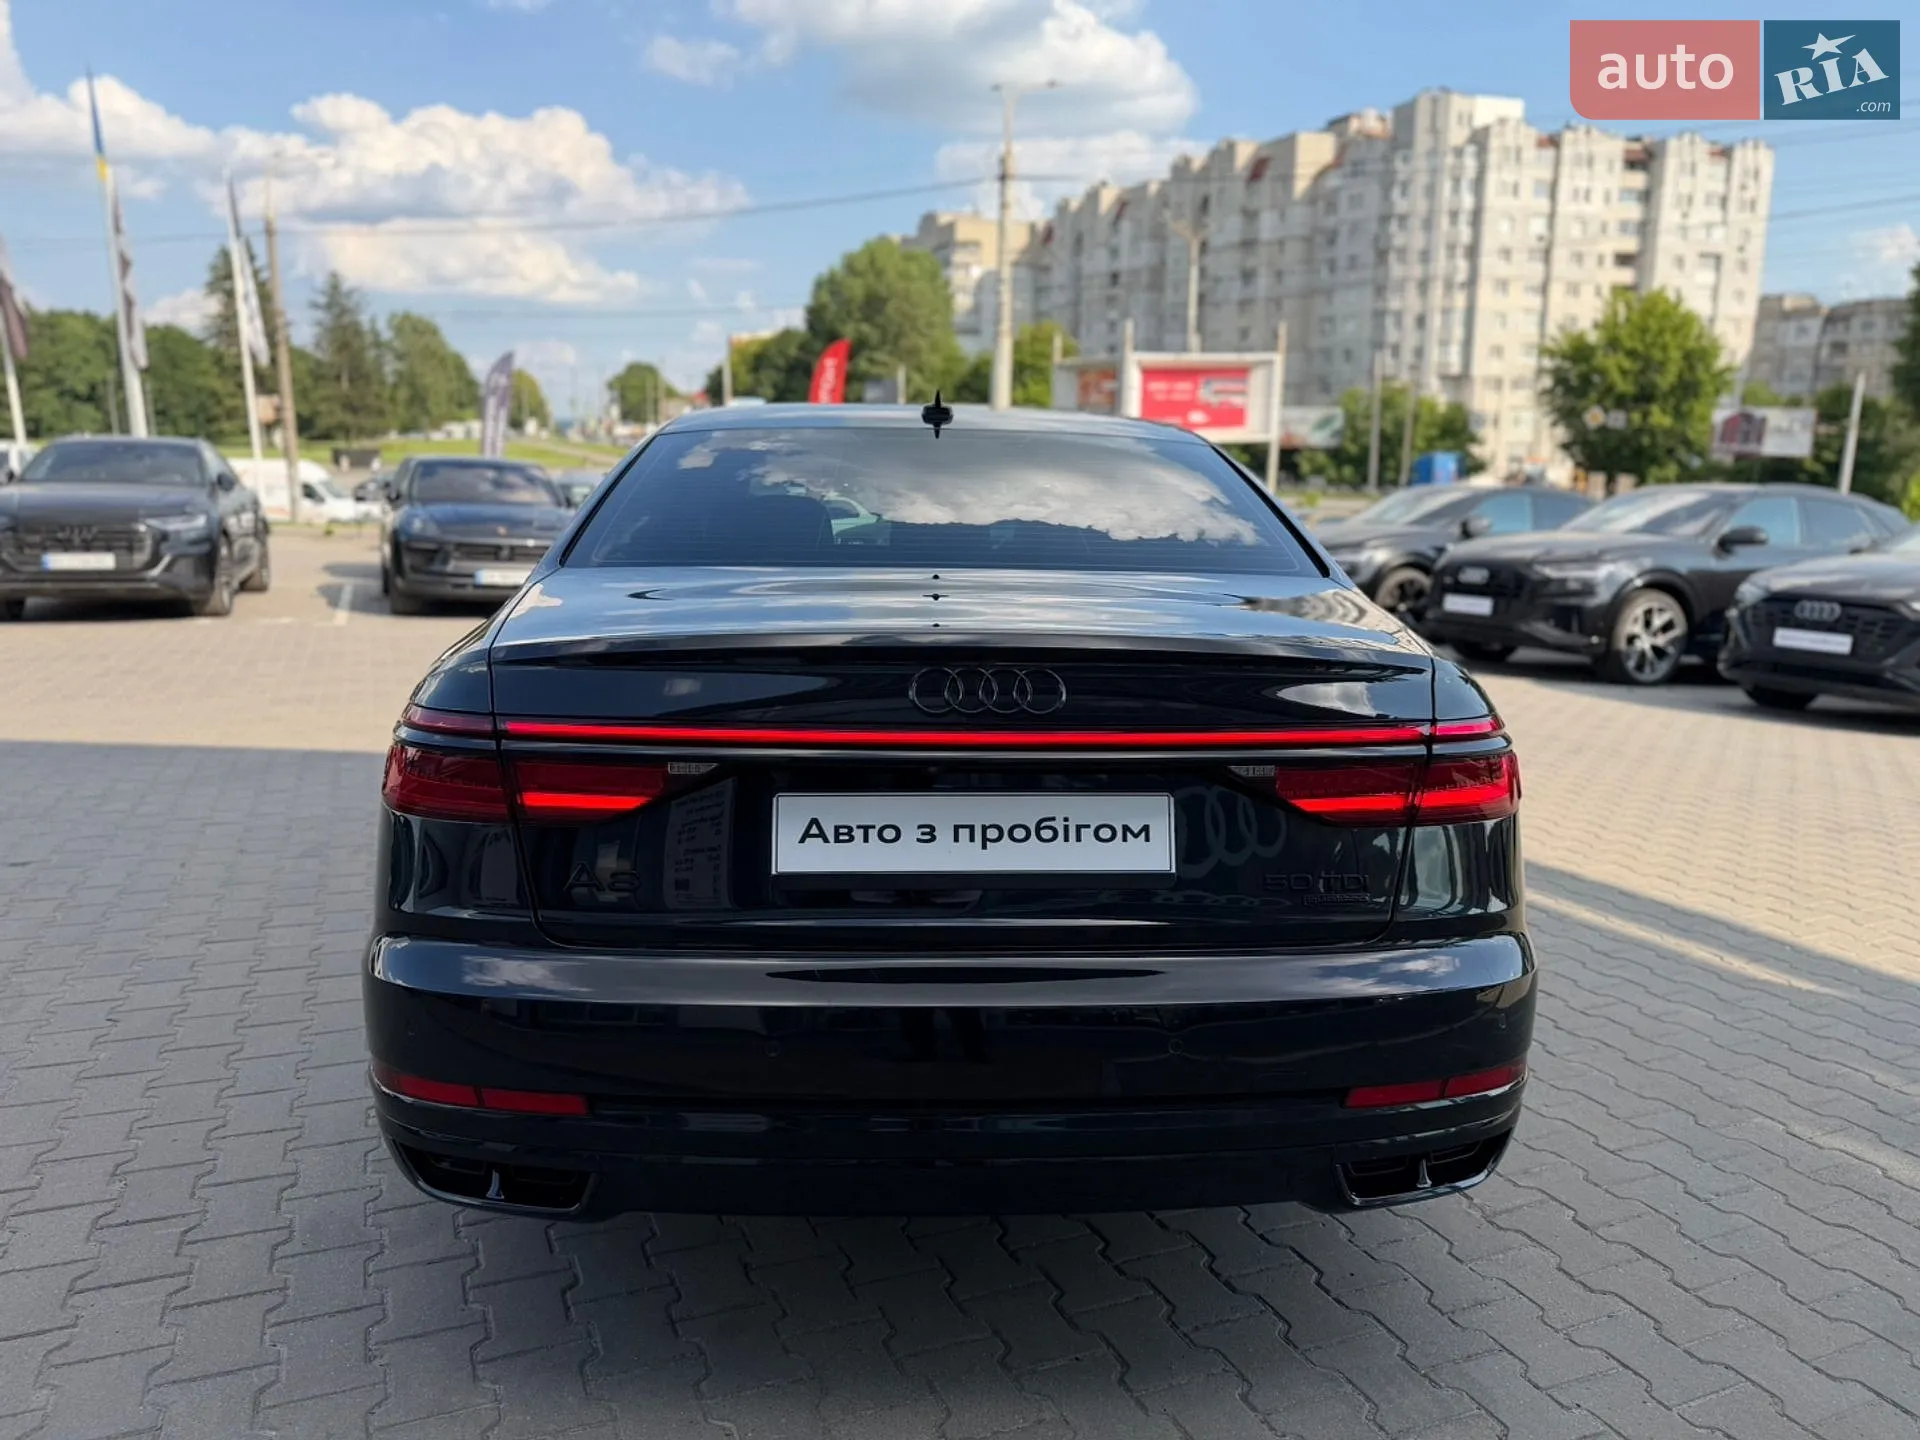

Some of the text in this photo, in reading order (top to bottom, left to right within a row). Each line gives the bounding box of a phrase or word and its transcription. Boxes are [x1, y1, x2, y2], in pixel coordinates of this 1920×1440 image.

[798, 815, 1151, 850] Авто з пробігом
[1264, 872, 1370, 892] 50 TDI
